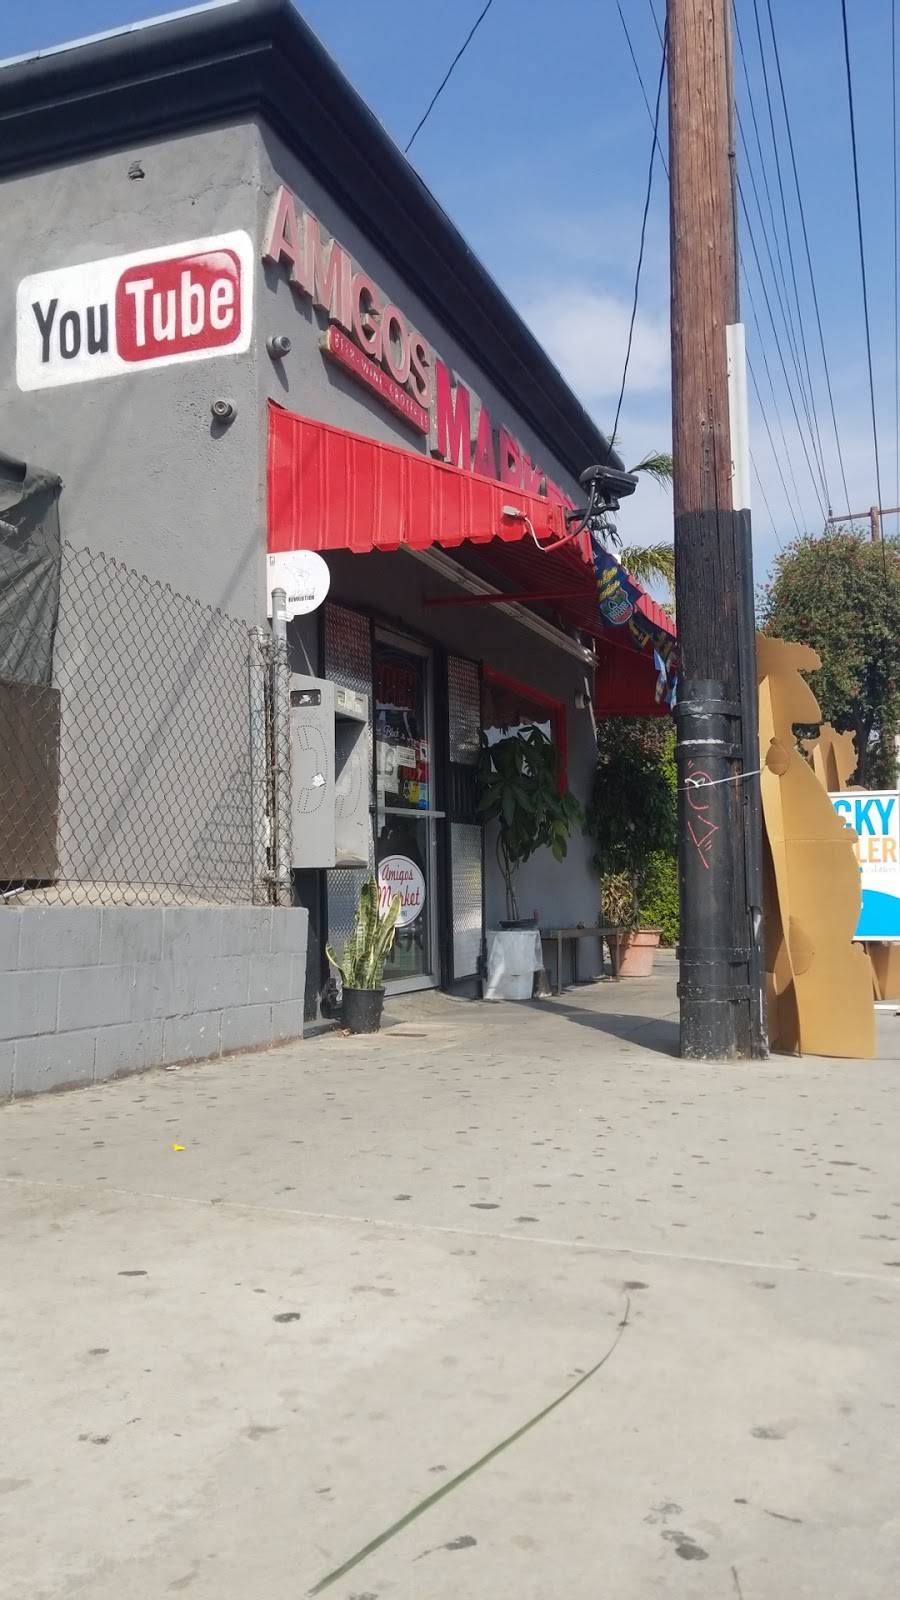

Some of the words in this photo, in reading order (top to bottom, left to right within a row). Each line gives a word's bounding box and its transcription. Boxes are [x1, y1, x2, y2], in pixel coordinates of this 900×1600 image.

[266, 184, 430, 410] AMIGOS
[382, 863, 414, 885] Amigos
[379, 886, 420, 908] Mrket
